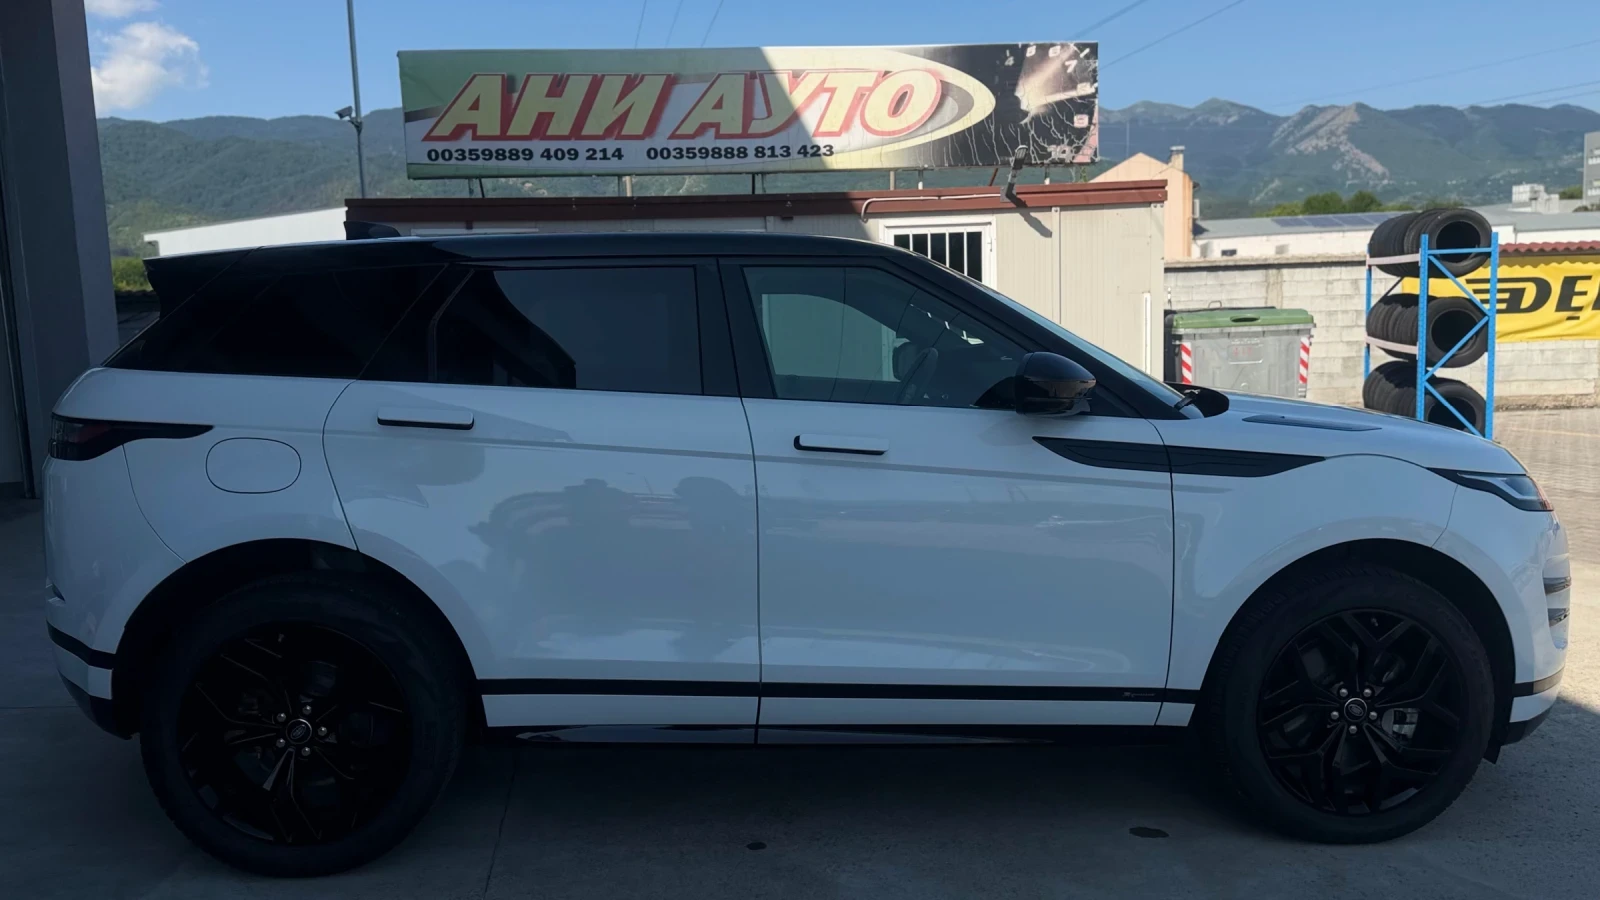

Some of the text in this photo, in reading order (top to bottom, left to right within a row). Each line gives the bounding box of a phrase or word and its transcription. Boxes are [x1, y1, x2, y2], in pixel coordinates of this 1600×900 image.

[421, 69, 942, 142] АНИ АУТО
[427, 144, 835, 162] 00359889 409 214 00359888 813 423
